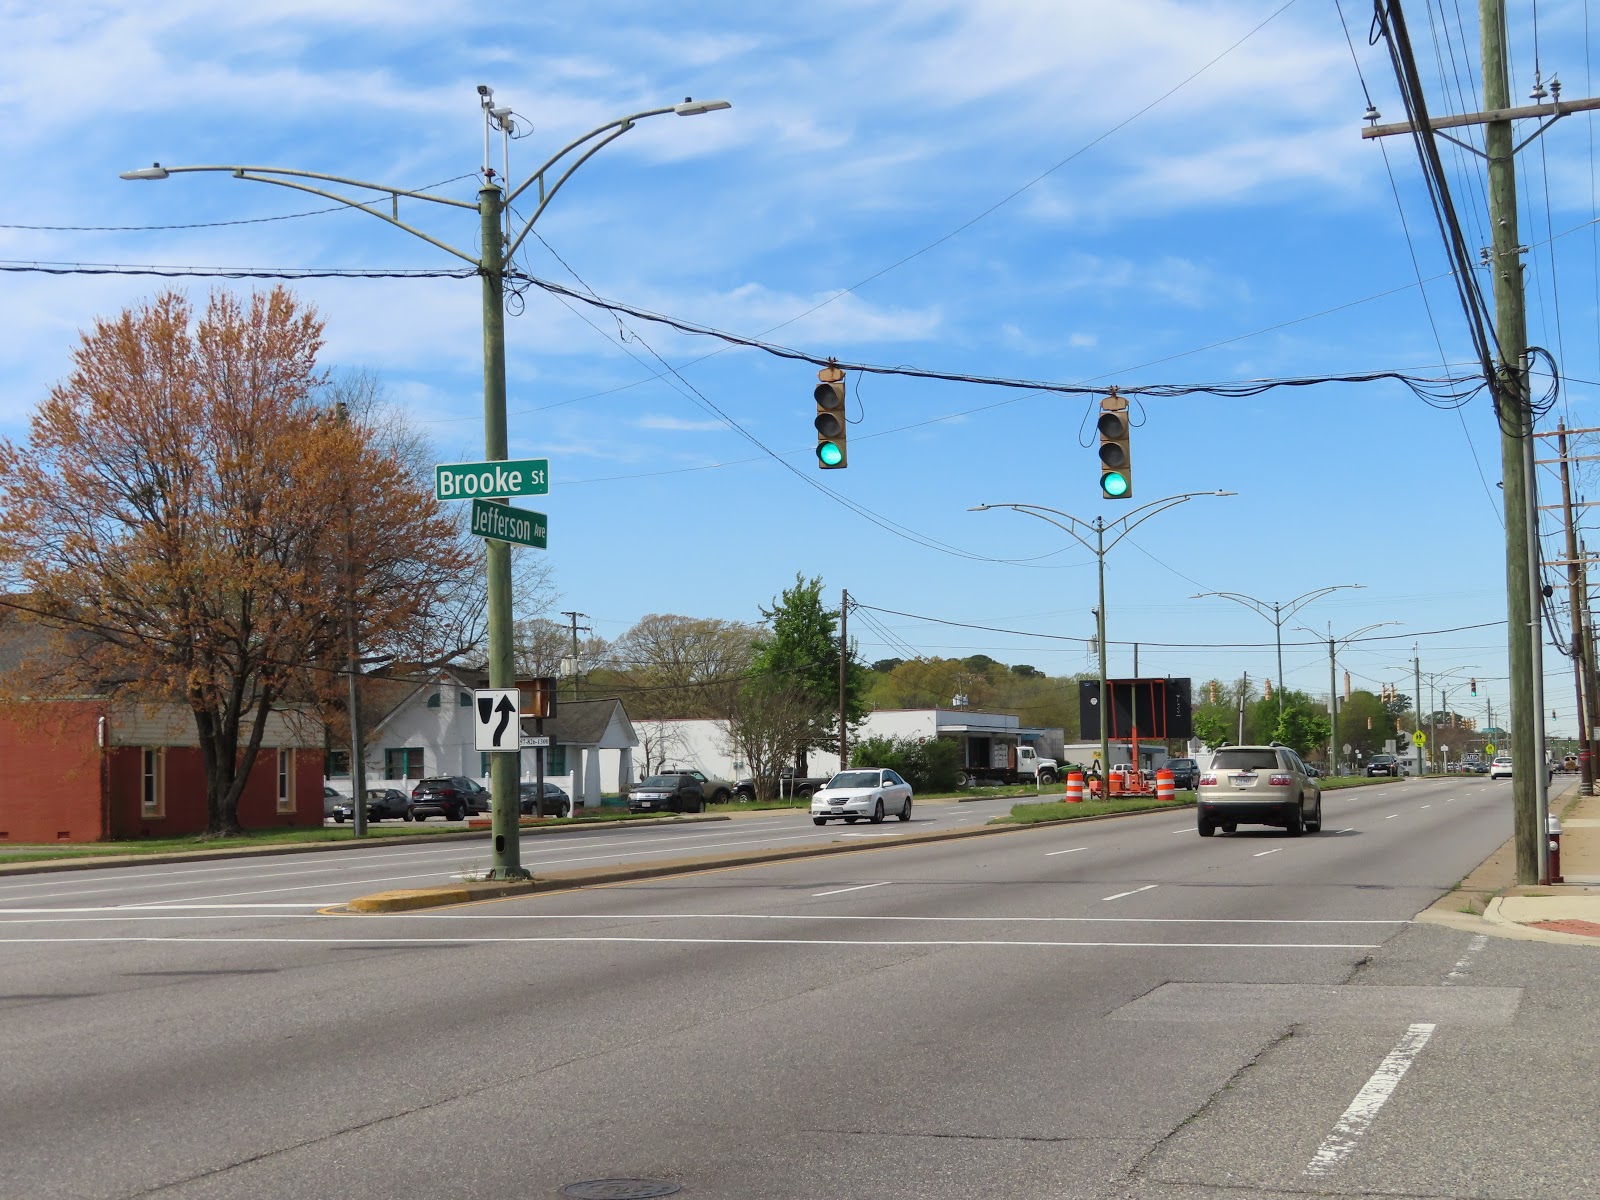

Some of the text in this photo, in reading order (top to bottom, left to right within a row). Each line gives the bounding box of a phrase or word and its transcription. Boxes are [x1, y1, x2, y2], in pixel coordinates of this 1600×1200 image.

[440, 466, 545, 496] Brooke St
[473, 506, 546, 541] Jefferson Ave
